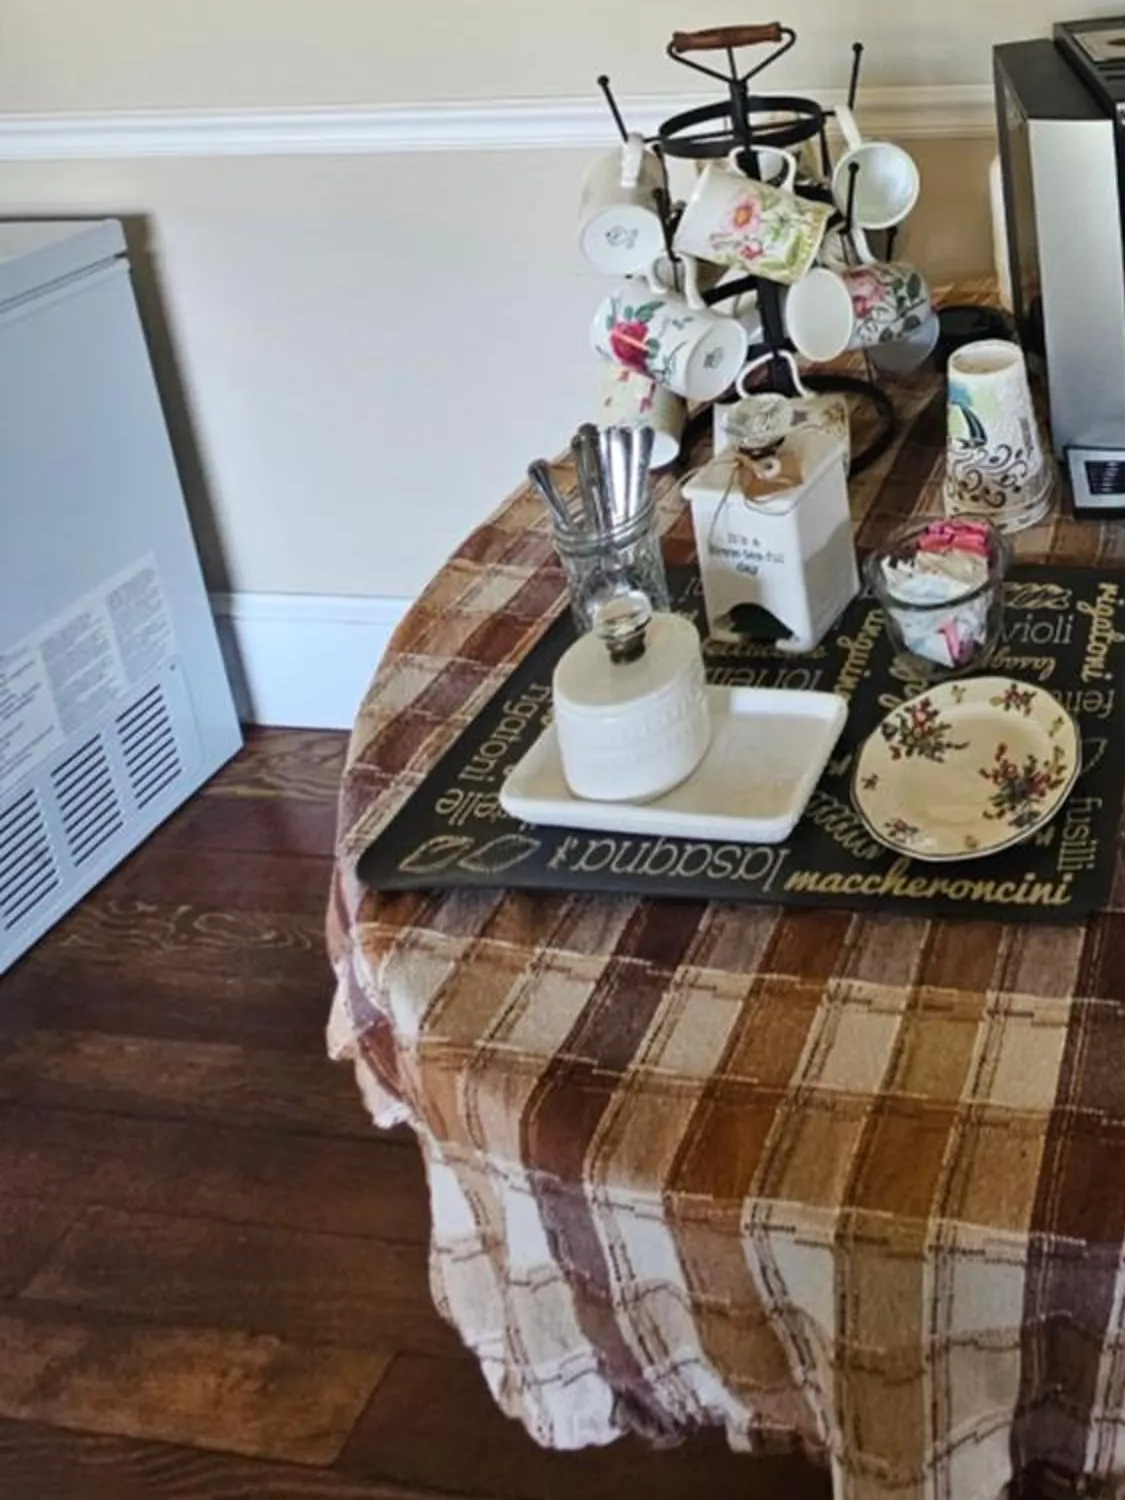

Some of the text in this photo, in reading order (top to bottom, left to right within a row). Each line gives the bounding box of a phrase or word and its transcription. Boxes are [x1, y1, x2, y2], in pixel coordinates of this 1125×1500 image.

[569, 835, 791, 893] lasagna
[1057, 797, 1103, 873] fusilli
[784, 856, 1073, 906] maccheroncini
